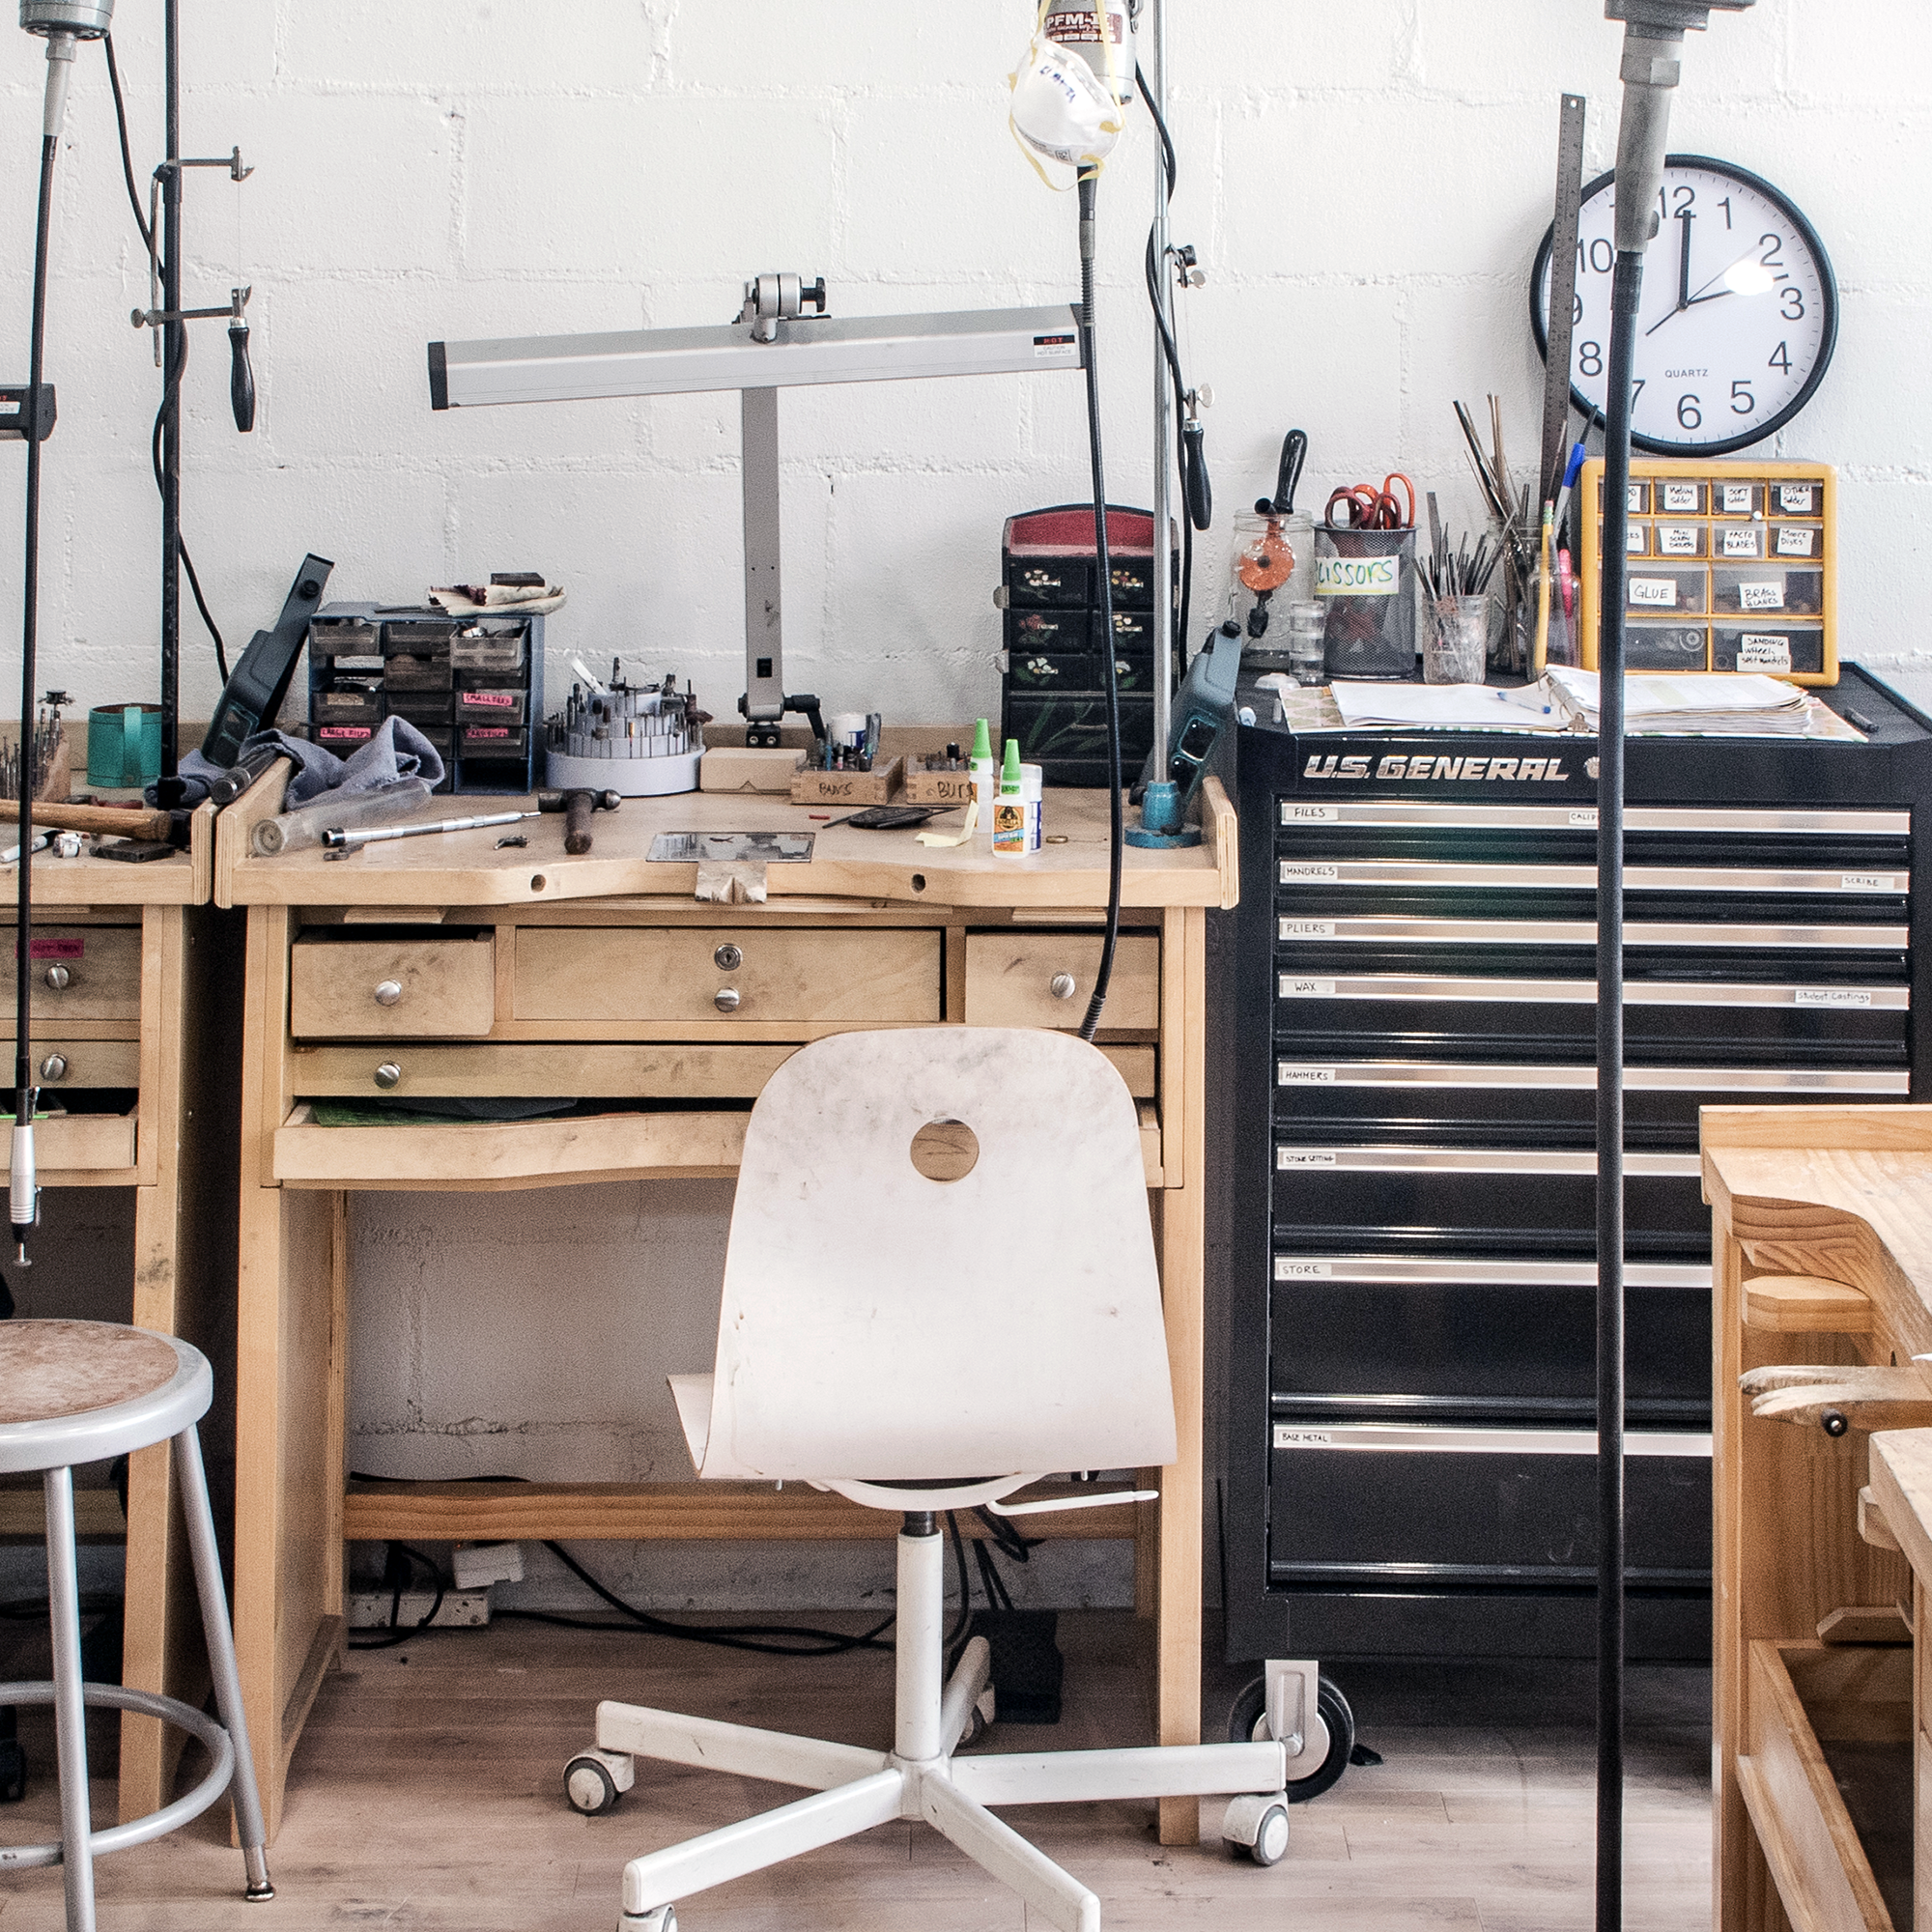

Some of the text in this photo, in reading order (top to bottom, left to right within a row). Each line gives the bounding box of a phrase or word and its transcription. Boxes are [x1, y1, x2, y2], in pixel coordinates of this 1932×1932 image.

[1658, 186, 1696, 219] 12
[1717, 197, 1732, 230] 1
[1577, 239, 1614, 273] 10
[1758, 234, 1784, 267] 2
[1780, 287, 1804, 320] 3
[1578, 342, 1604, 377] 8
[1768, 341, 1792, 375] 4
[1664, 369, 1709, 379] QUARTZ
[1730, 381, 1755, 414] 5
[1677, 394, 1702, 429] 6
[1634, 584, 1669, 599] GLUE
[1376, 755, 1570, 781] GENERAL
[1293, 808, 1326, 817] FILES
[1287, 867, 1335, 877] MANDRELS
[1844, 877, 1879, 887] SCRIBE
[1287, 923, 1326, 934] PLIERS
[1295, 981, 1317, 992] WAX
[1286, 1070, 1328, 1081] HAMMERS
[1282, 1265, 1321, 1274] STORE
